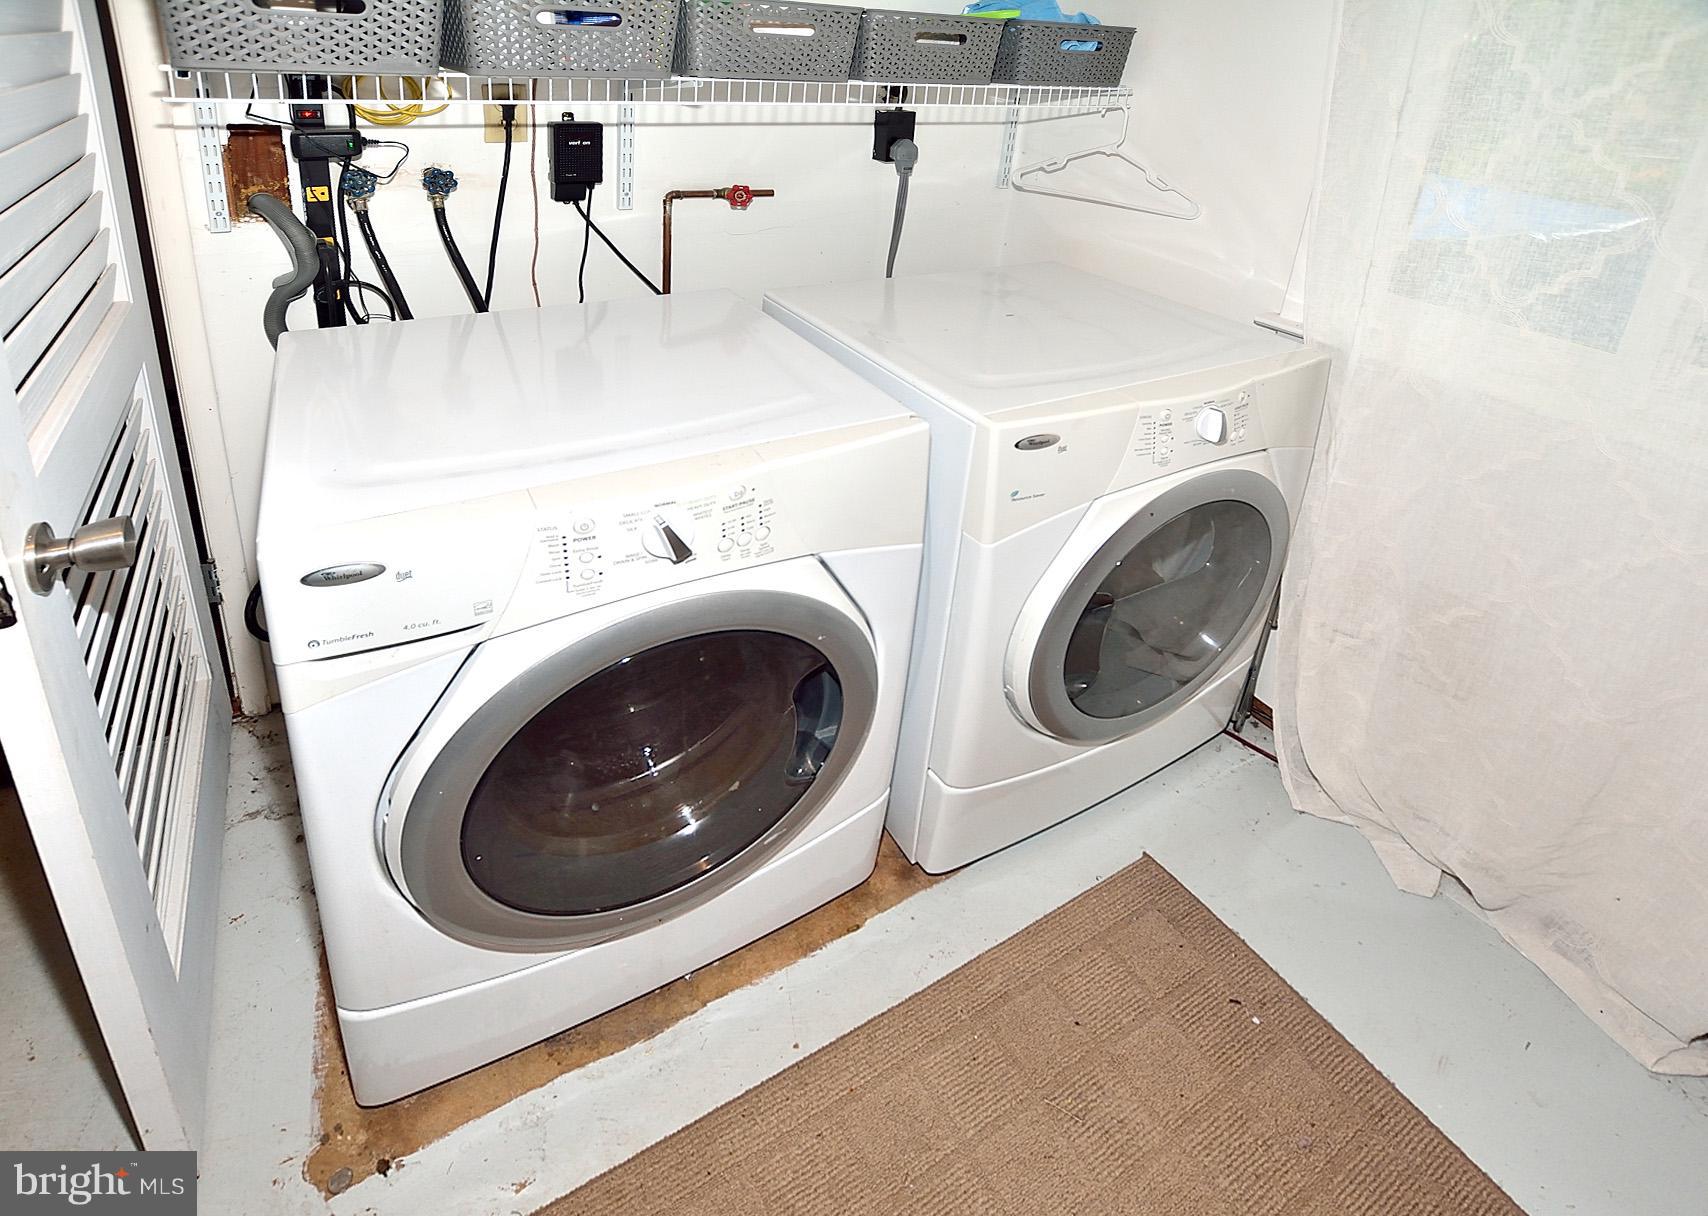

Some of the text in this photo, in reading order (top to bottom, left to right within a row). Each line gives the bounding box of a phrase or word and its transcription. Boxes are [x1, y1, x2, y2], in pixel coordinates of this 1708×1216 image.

[572, 535, 596, 543] POWER
[402, 618, 442, 631] 4.0 cu. ft.
[321, 631, 375, 646] TumbleFresh
